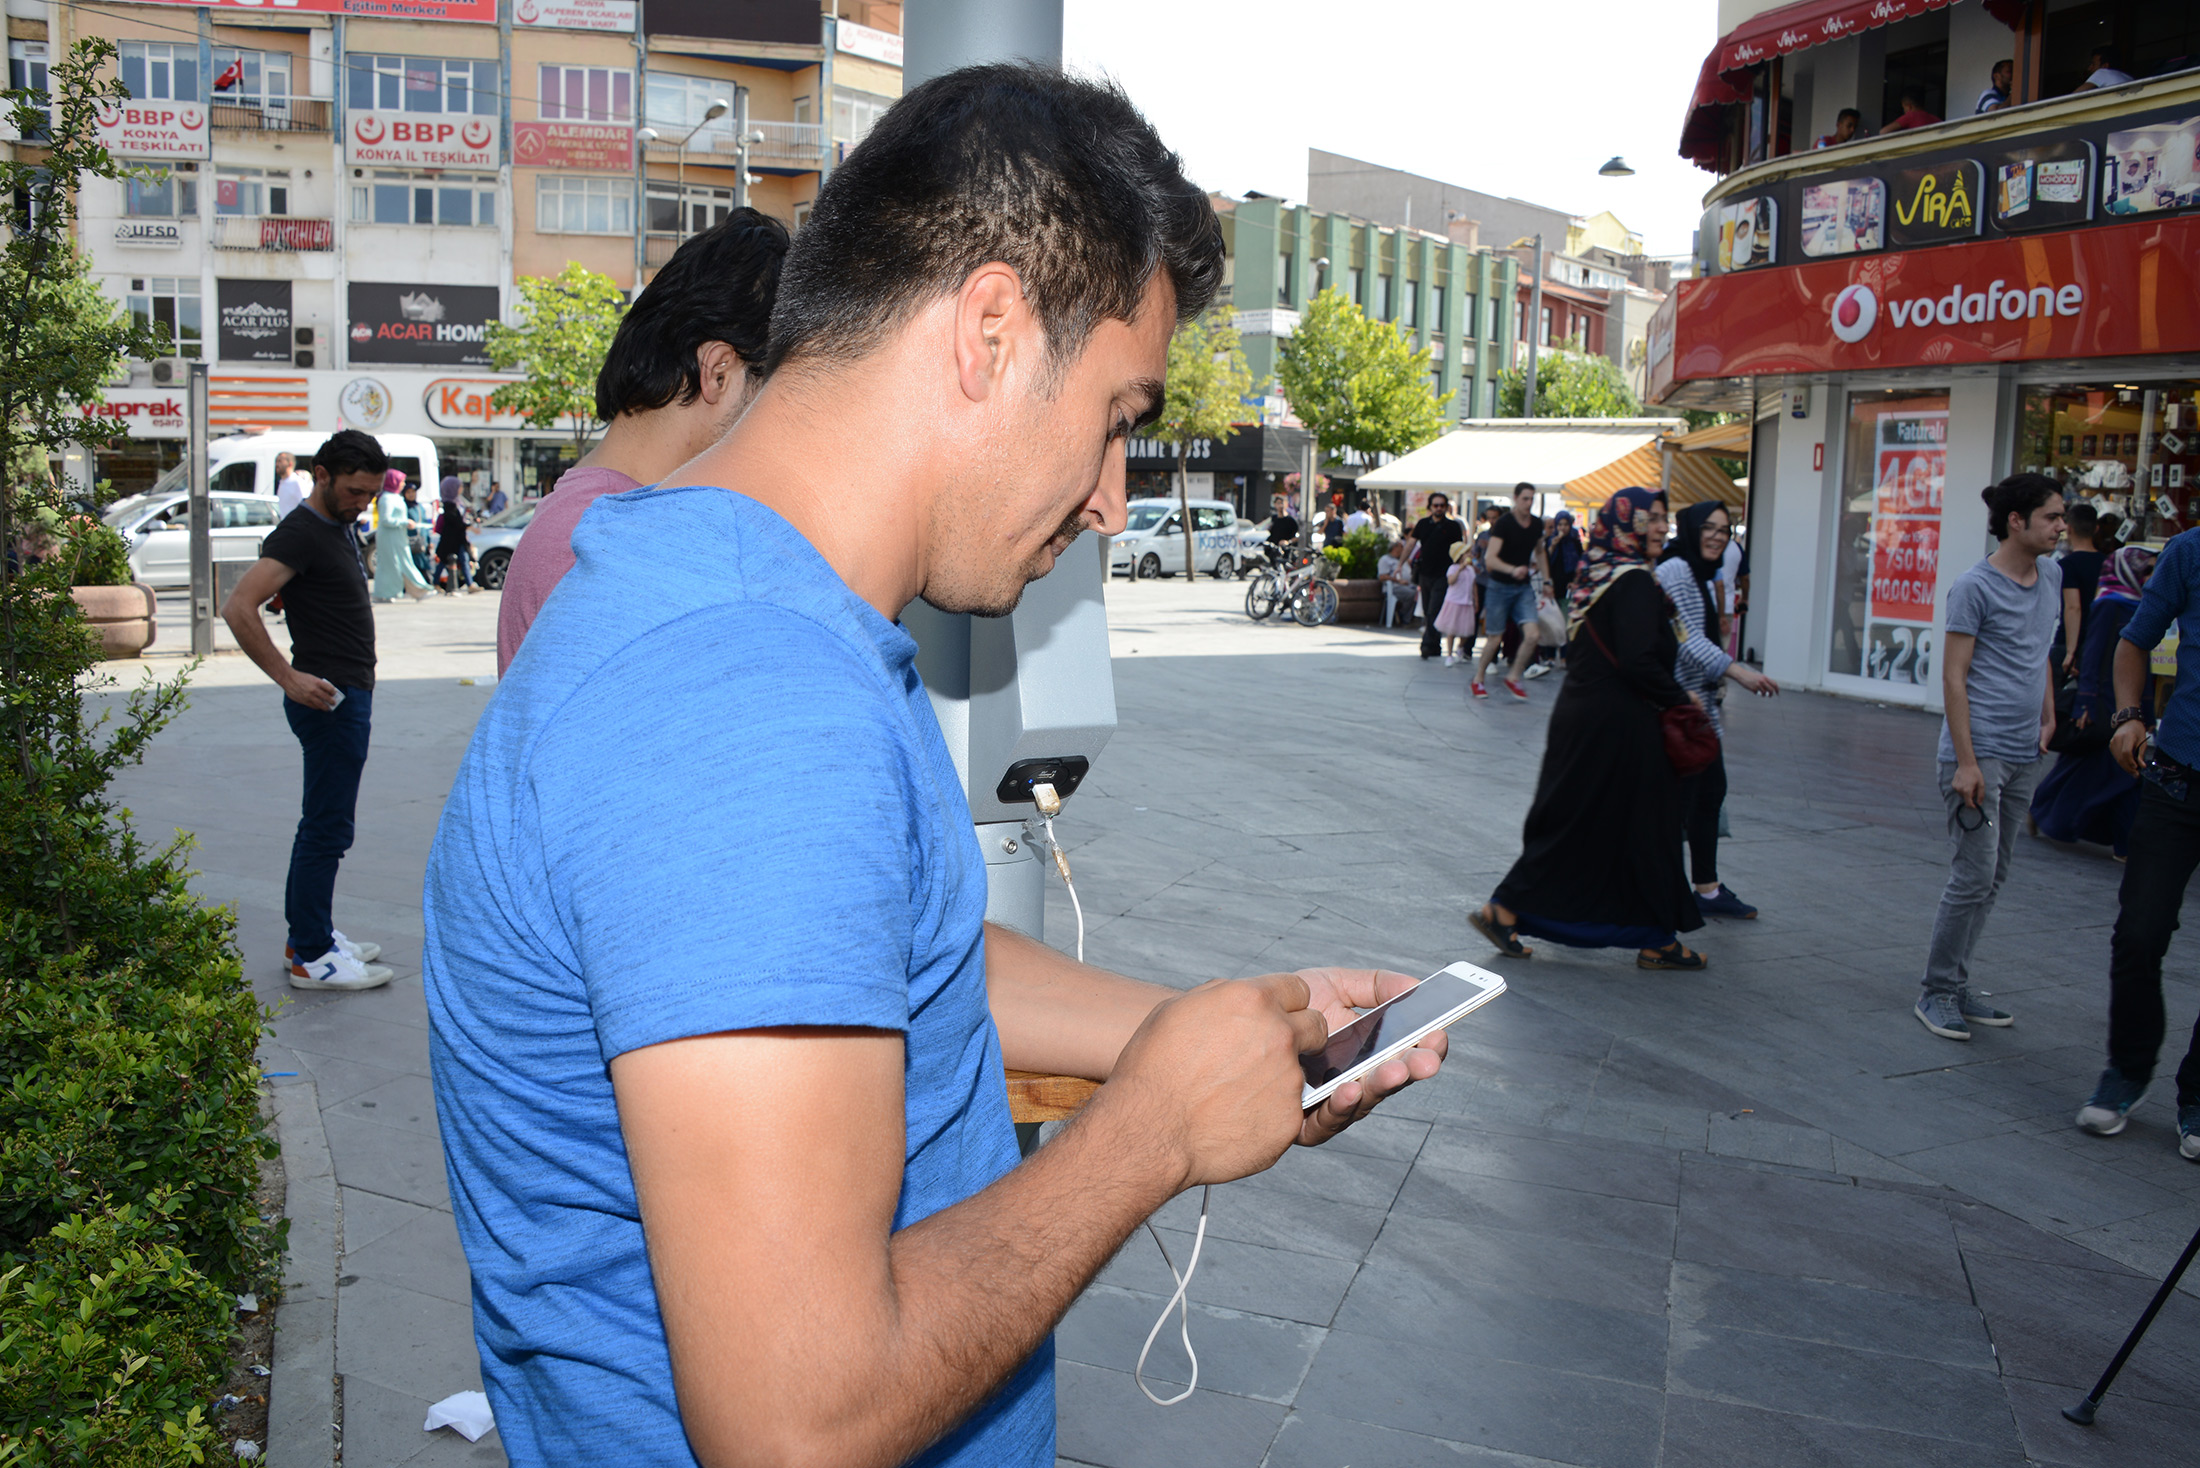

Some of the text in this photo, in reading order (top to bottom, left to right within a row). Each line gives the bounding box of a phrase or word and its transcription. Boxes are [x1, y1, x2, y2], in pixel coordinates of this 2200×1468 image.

[344, 1, 387, 12] Eğitim
[392, 3, 446, 15] Merkezi
[126, 109, 175, 126] BBP
[123, 129, 179, 140] KONYA
[392, 121, 455, 143] BBP
[546, 124, 629, 140] ALEMDAR
[119, 140, 203, 152] TEŞKİLATI
[356, 149, 490, 165] KONYA İL TEŞKİLATI
[1889, 279, 2083, 329] vodafone
[222, 316, 290, 328] ACAR PLUS
[377, 322, 433, 340] ACAR
[436, 323, 492, 343] HOM
[81, 398, 183, 421] yaprak
[1897, 420, 1944, 440] Faturalı
[1886, 547, 1913, 571] 750
[1874, 578, 1910, 602] 1000
